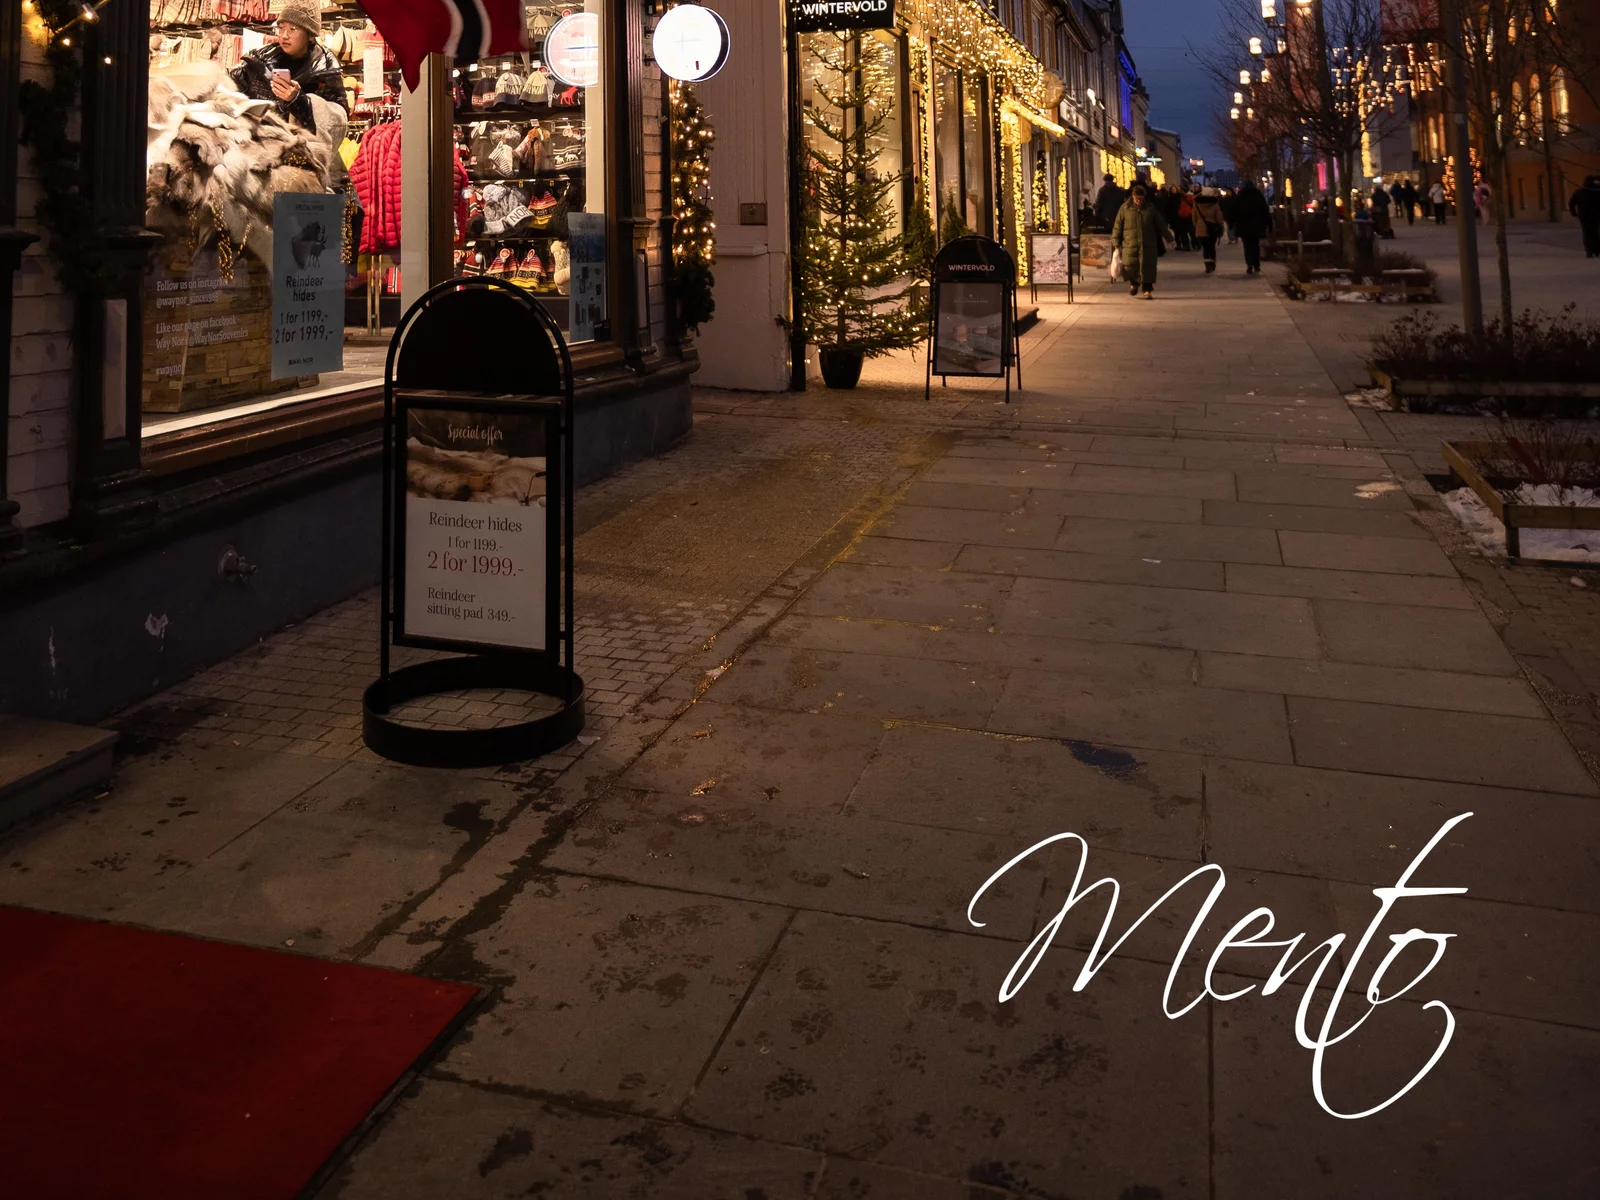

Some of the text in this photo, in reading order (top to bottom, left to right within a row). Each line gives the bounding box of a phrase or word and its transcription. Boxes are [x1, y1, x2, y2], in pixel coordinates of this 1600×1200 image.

[802, 0, 888, 15] WINTERVOLD
[948, 263, 996, 272] WINTERVOLD
[156, 280, 180, 292] Follow
[180, 281, 188, 290] us
[188, 280, 197, 289] on
[286, 275, 324, 288] Reindeer
[292, 289, 316, 302] hides
[280, 309, 328, 324] 1 for 1199,-
[156, 322, 171, 334] Like
[171, 323, 184, 333] our
[184, 321, 200, 333] page
[200, 320, 209, 329] on
[275, 324, 333, 344] 2 for 1999,-
[156, 338, 172, 351] Way
[172, 336, 184, 348] Nor
[447, 423, 504, 446] Special offer
[428, 511, 523, 533] Reindeer hides
[448, 535, 504, 552] 1 for 1199.-
[427, 551, 525, 577] 2 for 1999.-
[427, 586, 476, 603] Reindeer
[427, 602, 516, 622] sitting pad 349.-
